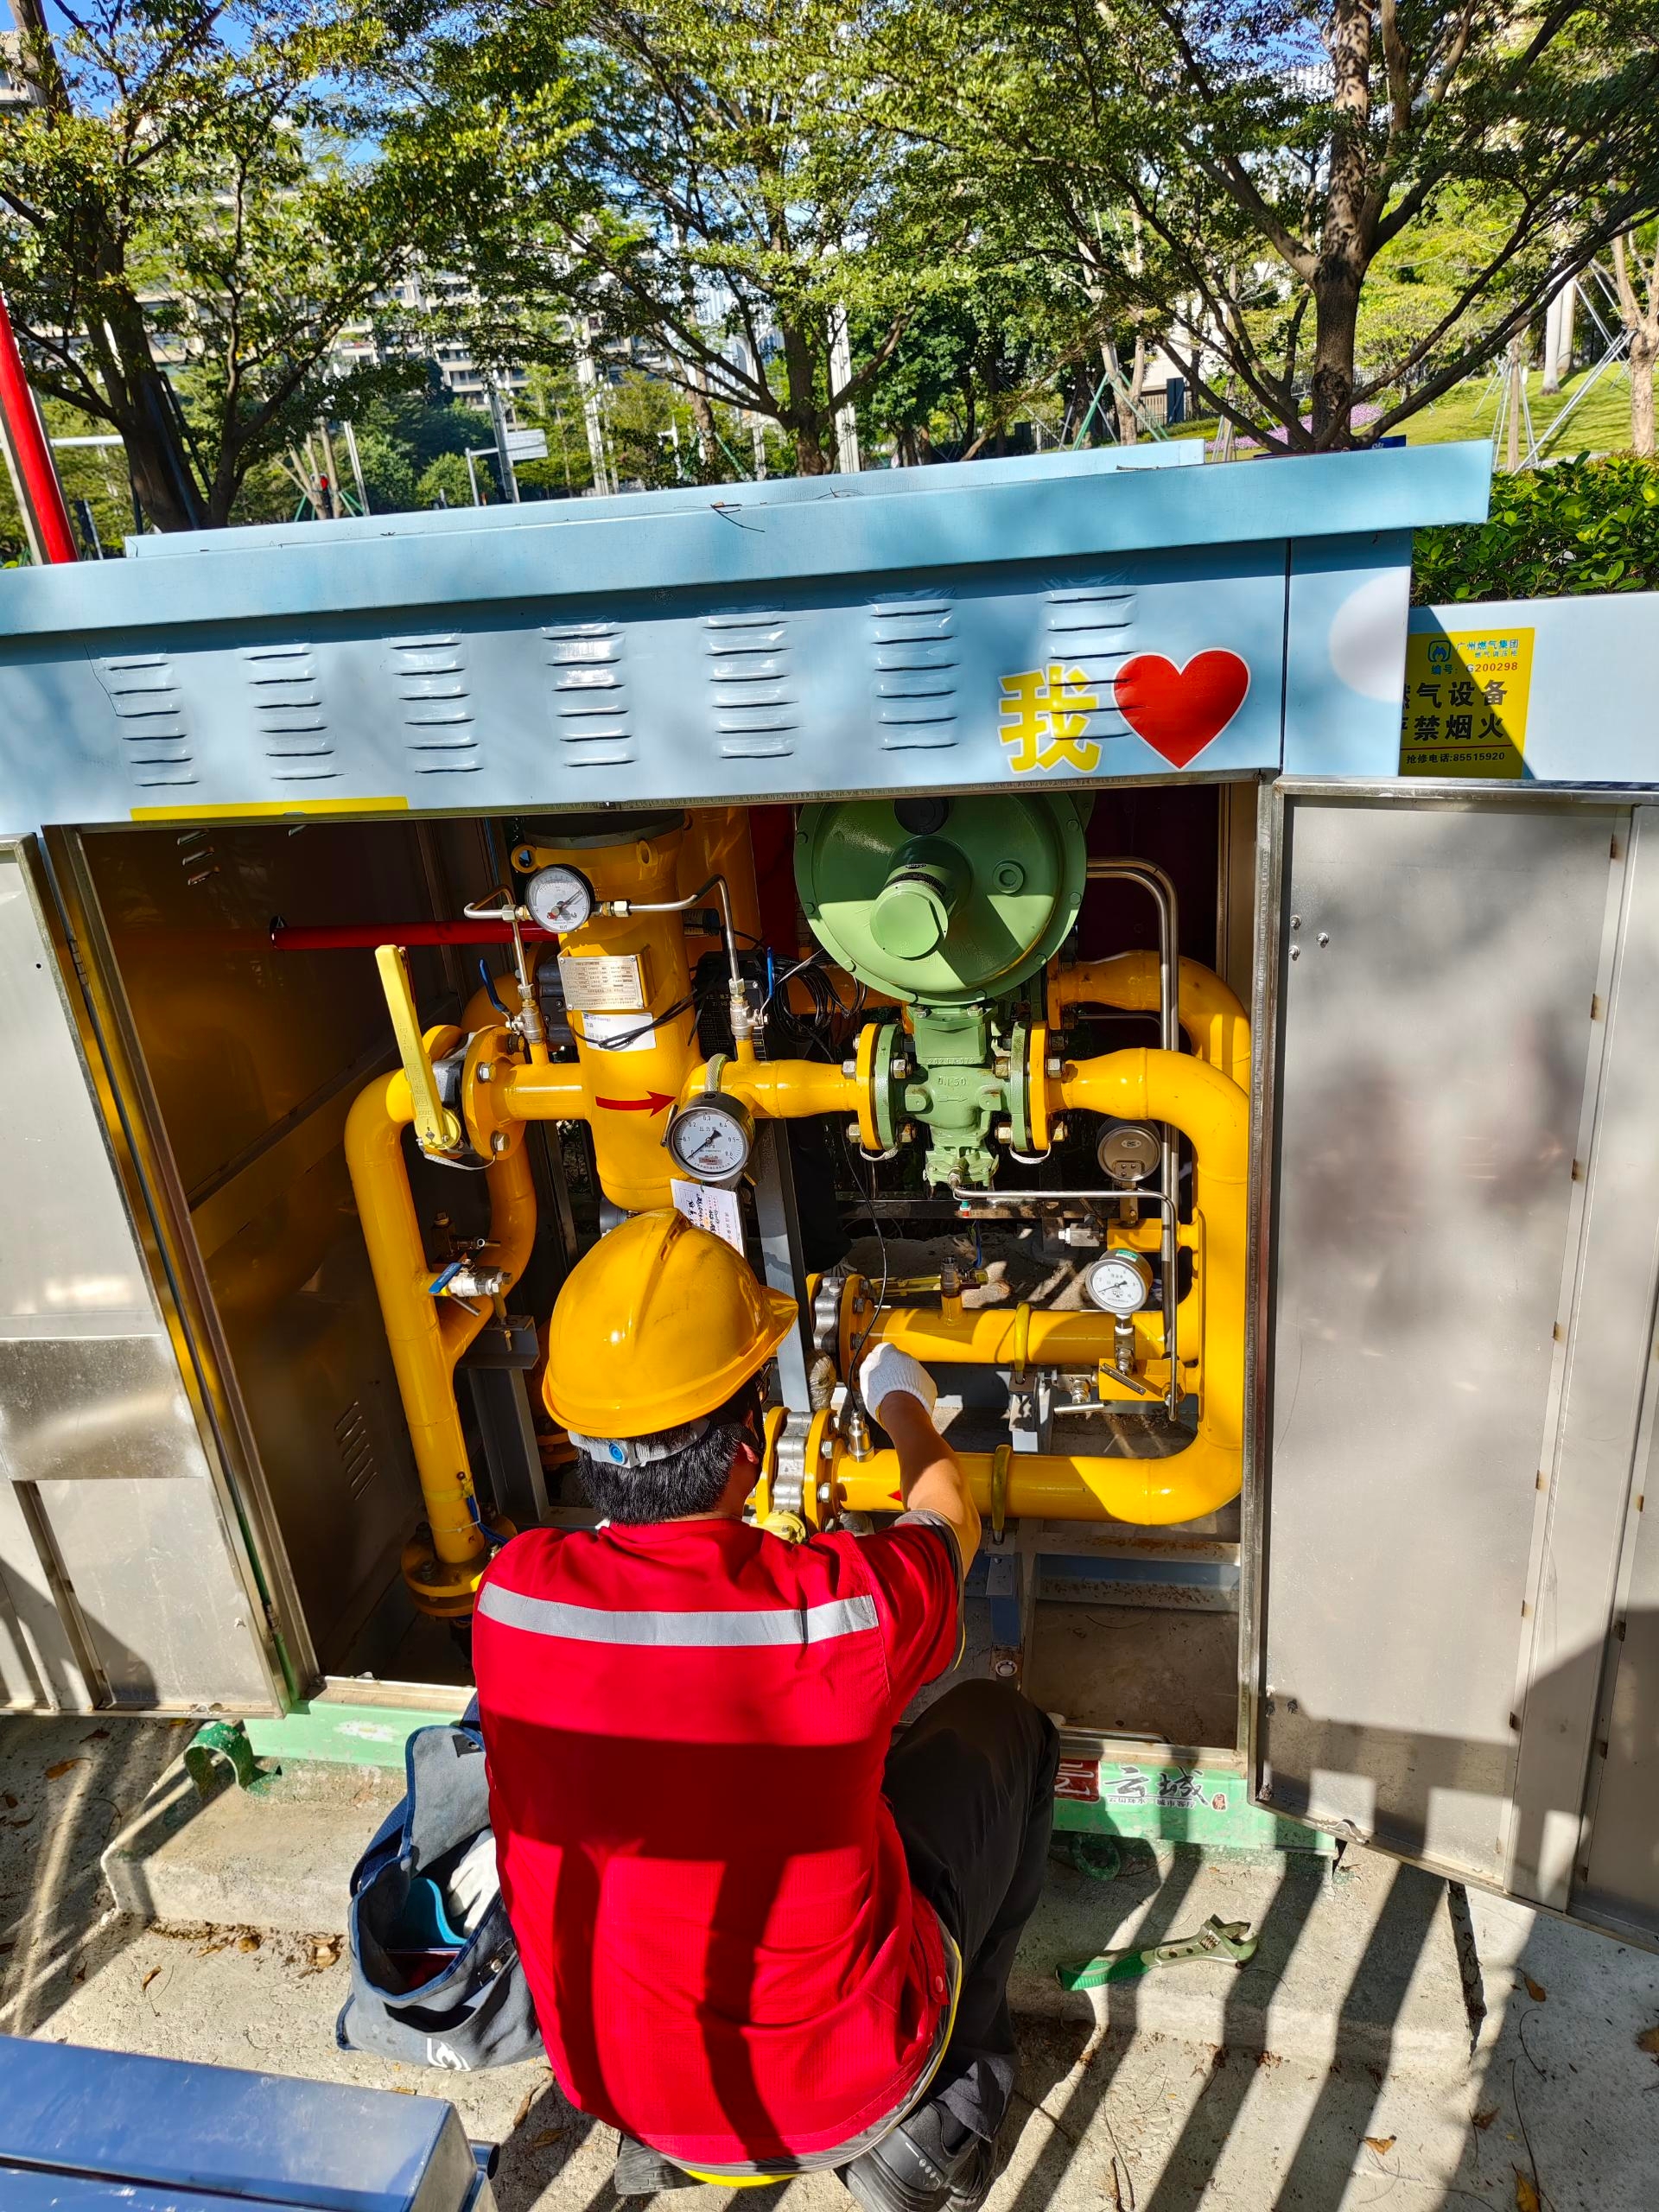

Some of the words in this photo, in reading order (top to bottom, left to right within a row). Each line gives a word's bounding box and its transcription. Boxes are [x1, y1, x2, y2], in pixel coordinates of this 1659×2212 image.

[1456, 639, 1519, 651] 广州燃气集团
[1466, 662, 1518, 673] G200298
[999, 664, 1103, 774] 我
[1104, 1766, 1209, 1806] 云城
